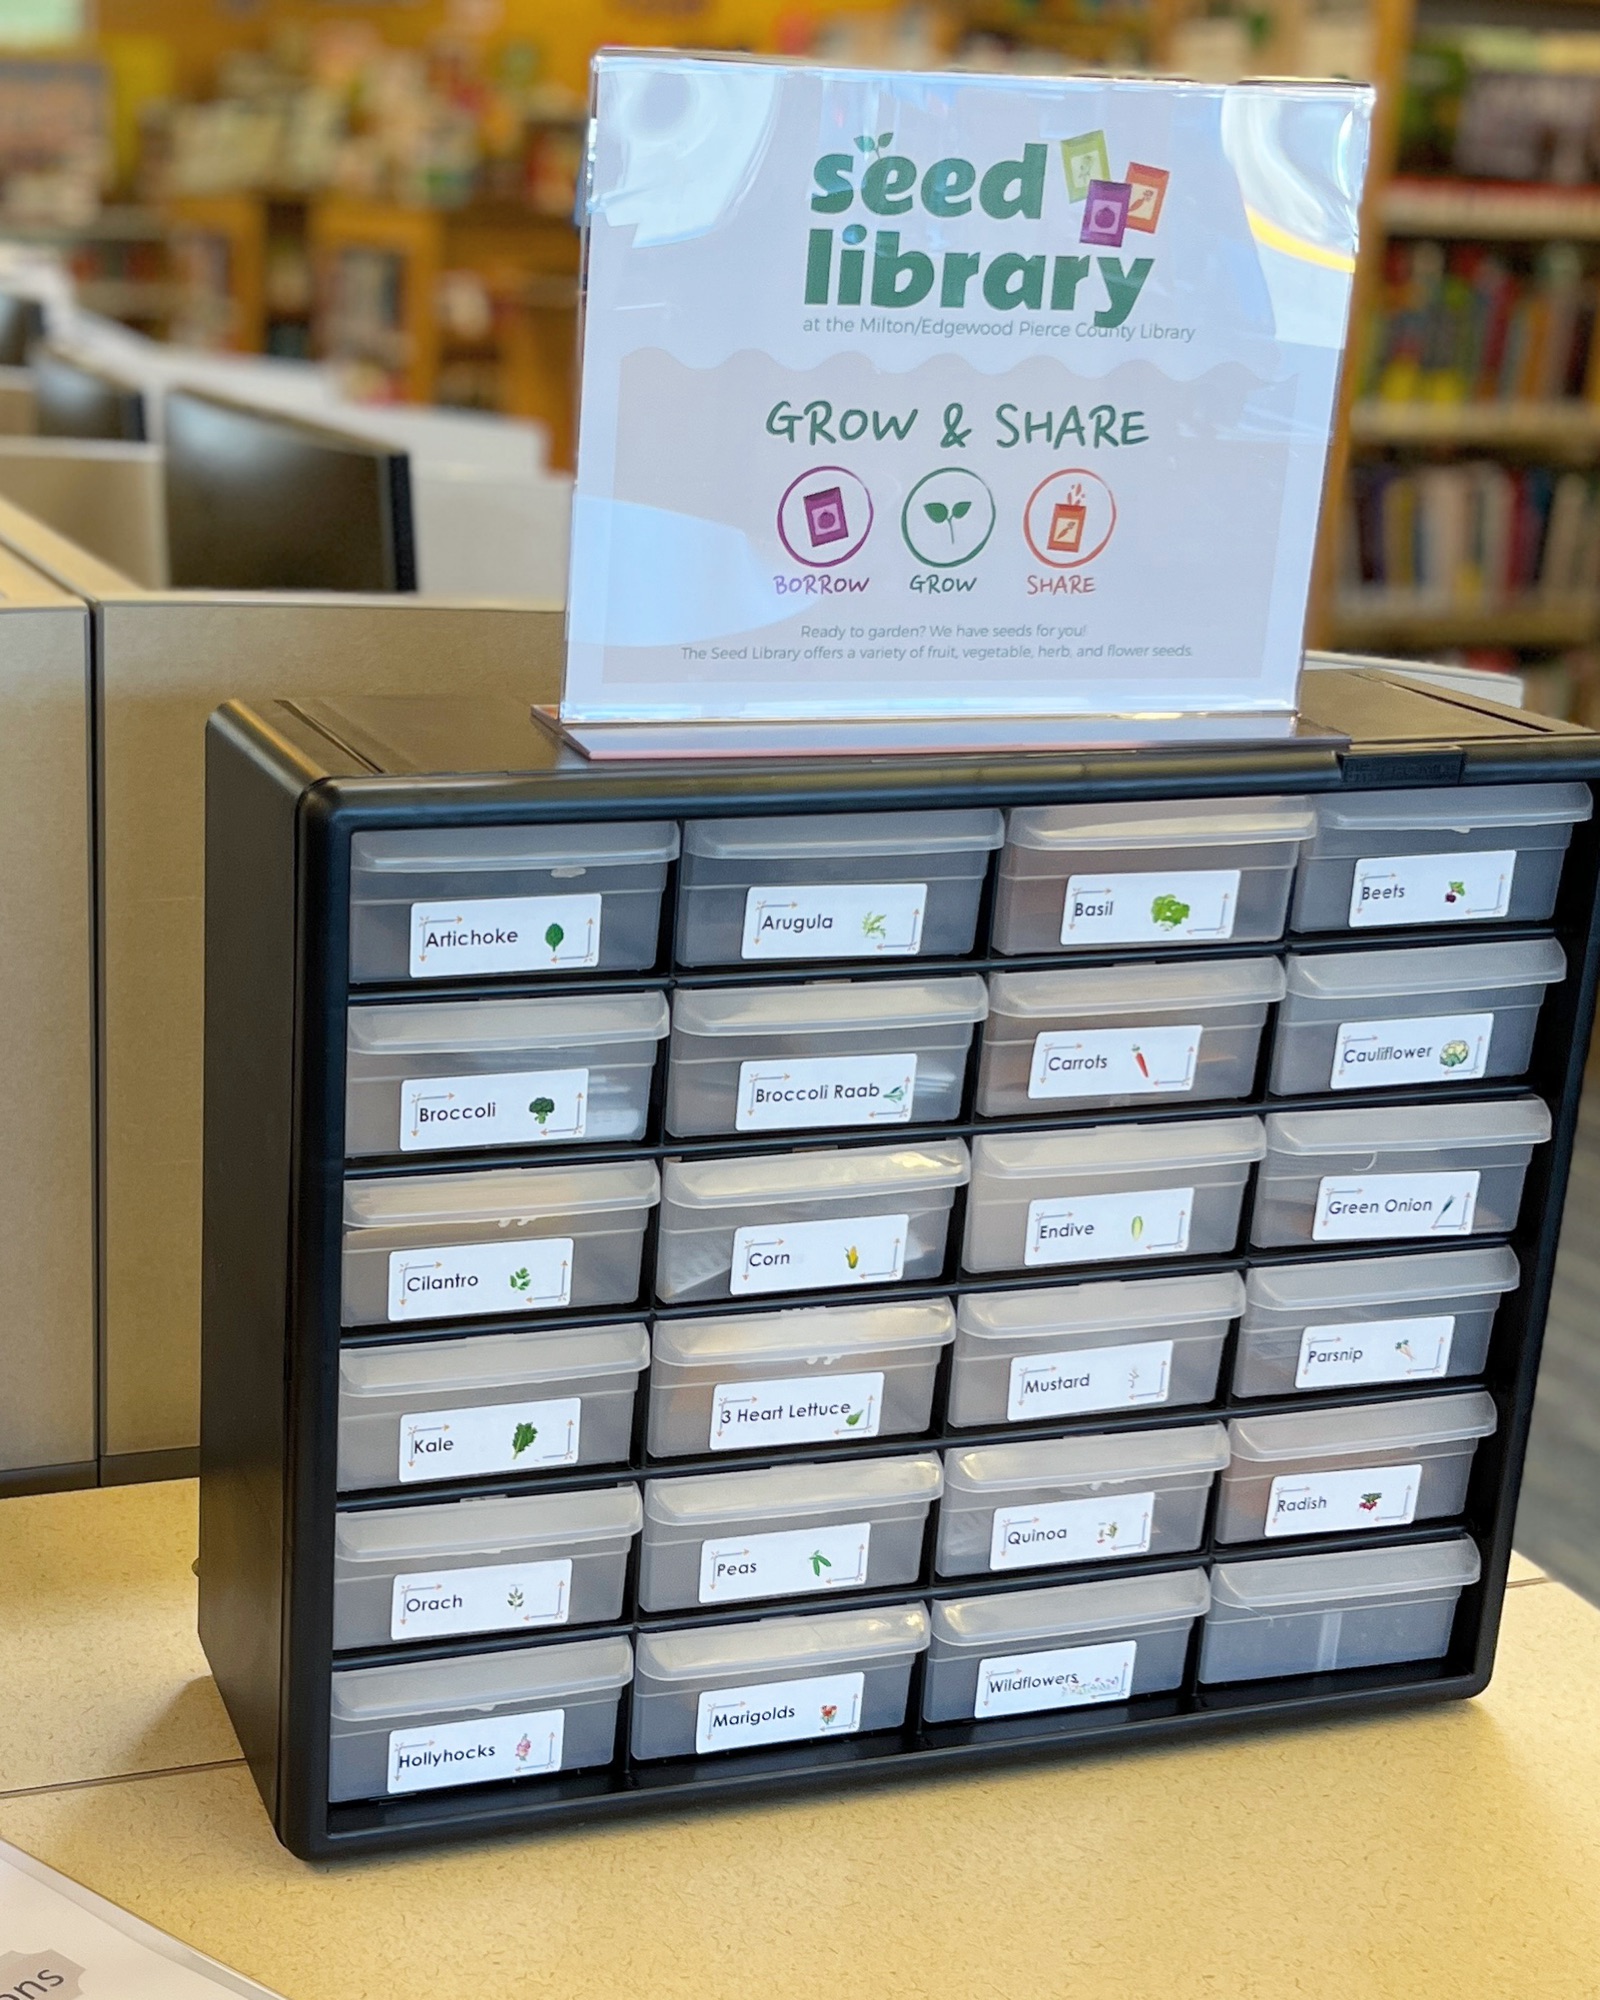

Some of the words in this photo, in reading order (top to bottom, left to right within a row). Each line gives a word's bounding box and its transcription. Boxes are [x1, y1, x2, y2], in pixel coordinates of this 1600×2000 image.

[811, 143, 1048, 219] seed
[804, 224, 1154, 328] library
[803, 318, 820, 332] at
[826, 316, 854, 332] the
[860, 317, 1013, 338] Milton/Edgewood
[1019, 321, 1070, 337] Pierce
[1075, 323, 1136, 341] County
[1141, 324, 1196, 343] Library
[766, 400, 918, 445] GROW
[940, 403, 972, 447] &
[996, 403, 1149, 450] SHARE
[773, 575, 870, 595] BORROW
[908, 575, 977, 594] GROW
[1026, 575, 1096, 595] SHARE
[800, 625, 846, 640] Ready
[850, 626, 864, 638] to
[868, 625, 926, 640] garden?
[929, 625, 952, 637] We
[957, 625, 989, 637] have
[992, 625, 1032, 637] seeds
[1036, 624, 1055, 637] for
[1057, 624, 1087, 639] you!
[682, 647, 706, 659] The
[711, 647, 747, 660] Seed
[752, 646, 800, 662] Library
[804, 646, 843, 659] offers
[847, 650, 856, 659] a
[860, 646, 905, 661] variety
[909, 646, 925, 659] of
[927, 646, 958, 660] fruit,
[962, 645, 1034, 661] vegetable,
[1076, 645, 1103, 657] and
[1107, 644, 1149, 657] flower
[1361, 882, 1405, 901] Beets
[1074, 899, 1114, 918] Basil
[761, 912, 833, 935] Arugula
[425, 925, 518, 948] Artichoke
[1048, 1053, 1107, 1072] Carrots
[1343, 1043, 1432, 1064] Cauliflower
[755, 1084, 828, 1104] Broccoli
[834, 1081, 880, 1101] Raab
[419, 1101, 496, 1123] Broccoli
[1329, 1199, 1378, 1215] Green
[1384, 1197, 1432, 1213] Onion
[1040, 1221, 1094, 1239] Endive
[749, 1250, 790, 1268] Corn
[407, 1271, 479, 1292] Cilantro
[1308, 1344, 1363, 1364] Parsnip
[1024, 1373, 1090, 1394] Mustard
[721, 1408, 732, 1425] 3
[737, 1404, 783, 1423] Heart
[788, 1399, 851, 1418] Lettuce
[413, 1436, 454, 1454] Kale
[1277, 1495, 1327, 1514] Radish
[1007, 1526, 1067, 1545] Quinoa
[717, 1560, 757, 1577] Peas
[406, 1594, 463, 1612] Orach
[989, 1670, 1079, 1694] Wildflowers
[713, 1704, 795, 1728] Marigolds
[398, 1743, 496, 1769] Hollyhocks
